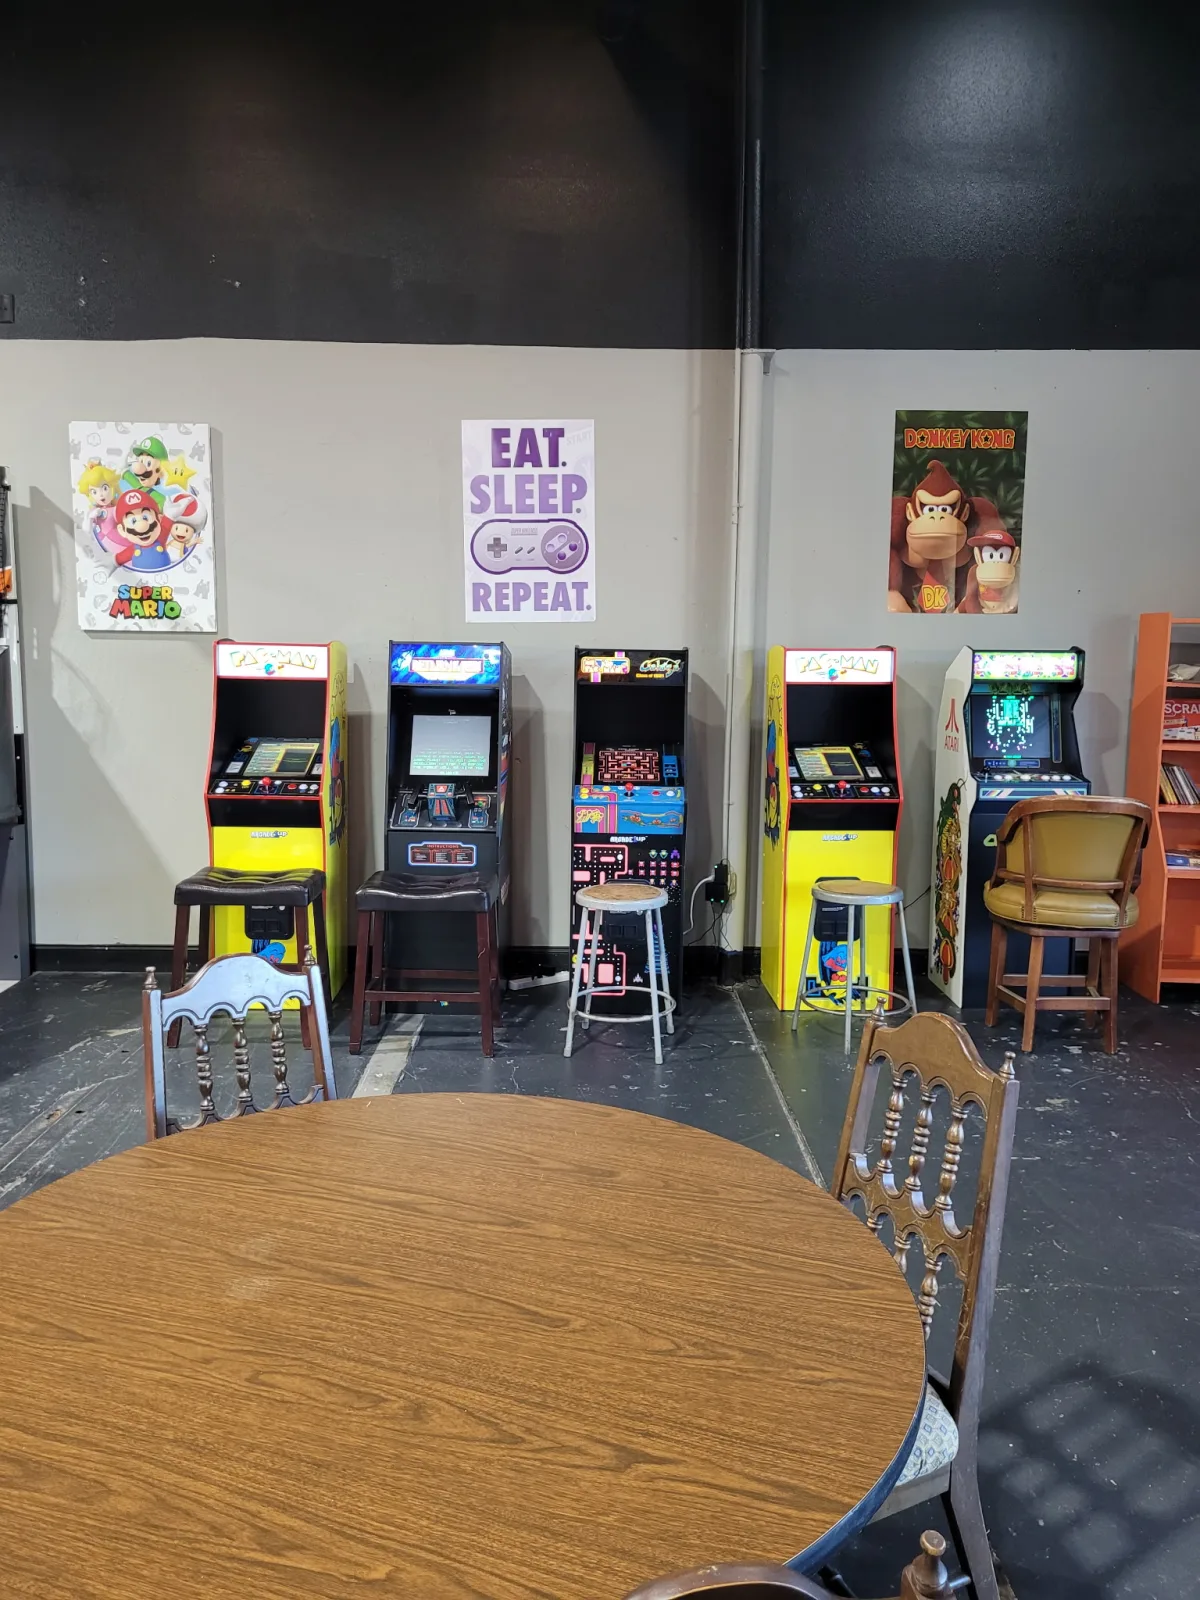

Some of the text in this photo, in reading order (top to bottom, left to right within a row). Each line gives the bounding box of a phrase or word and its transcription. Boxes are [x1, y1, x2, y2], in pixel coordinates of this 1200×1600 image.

[491, 427, 567, 468] EAT.
[904, 428, 1015, 450] DONKEY KONG
[470, 474, 588, 514] SLEEP.
[117, 584, 174, 601] SUPER
[472, 581, 592, 612] REPEAT.
[922, 585, 947, 609] DK
[109, 599, 182, 620] MARIO
[1164, 703, 1200, 715] SCRA
[944, 735, 960, 752] ATARI
